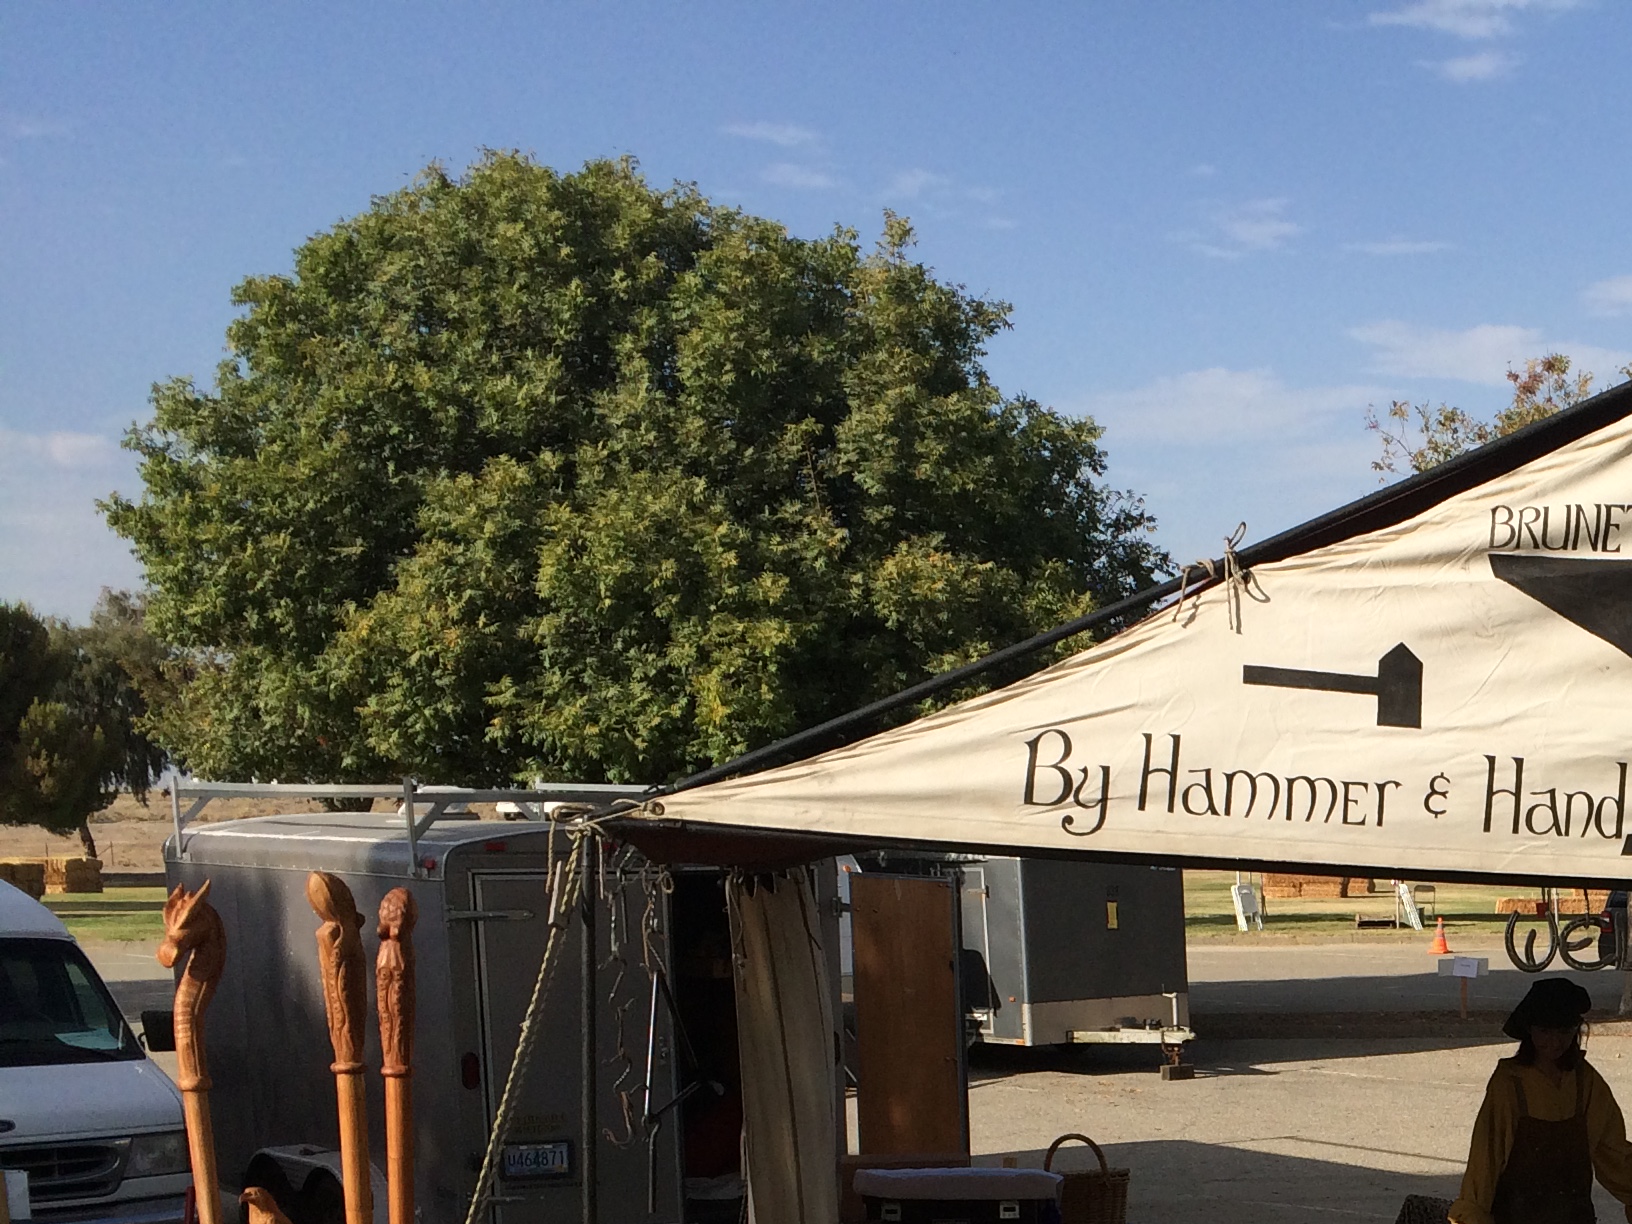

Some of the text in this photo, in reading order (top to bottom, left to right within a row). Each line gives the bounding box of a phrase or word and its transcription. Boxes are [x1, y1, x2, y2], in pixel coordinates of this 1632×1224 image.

[1023, 729, 1629, 840] By Hammer & Hand
[507, 1151, 565, 1168] U464871
